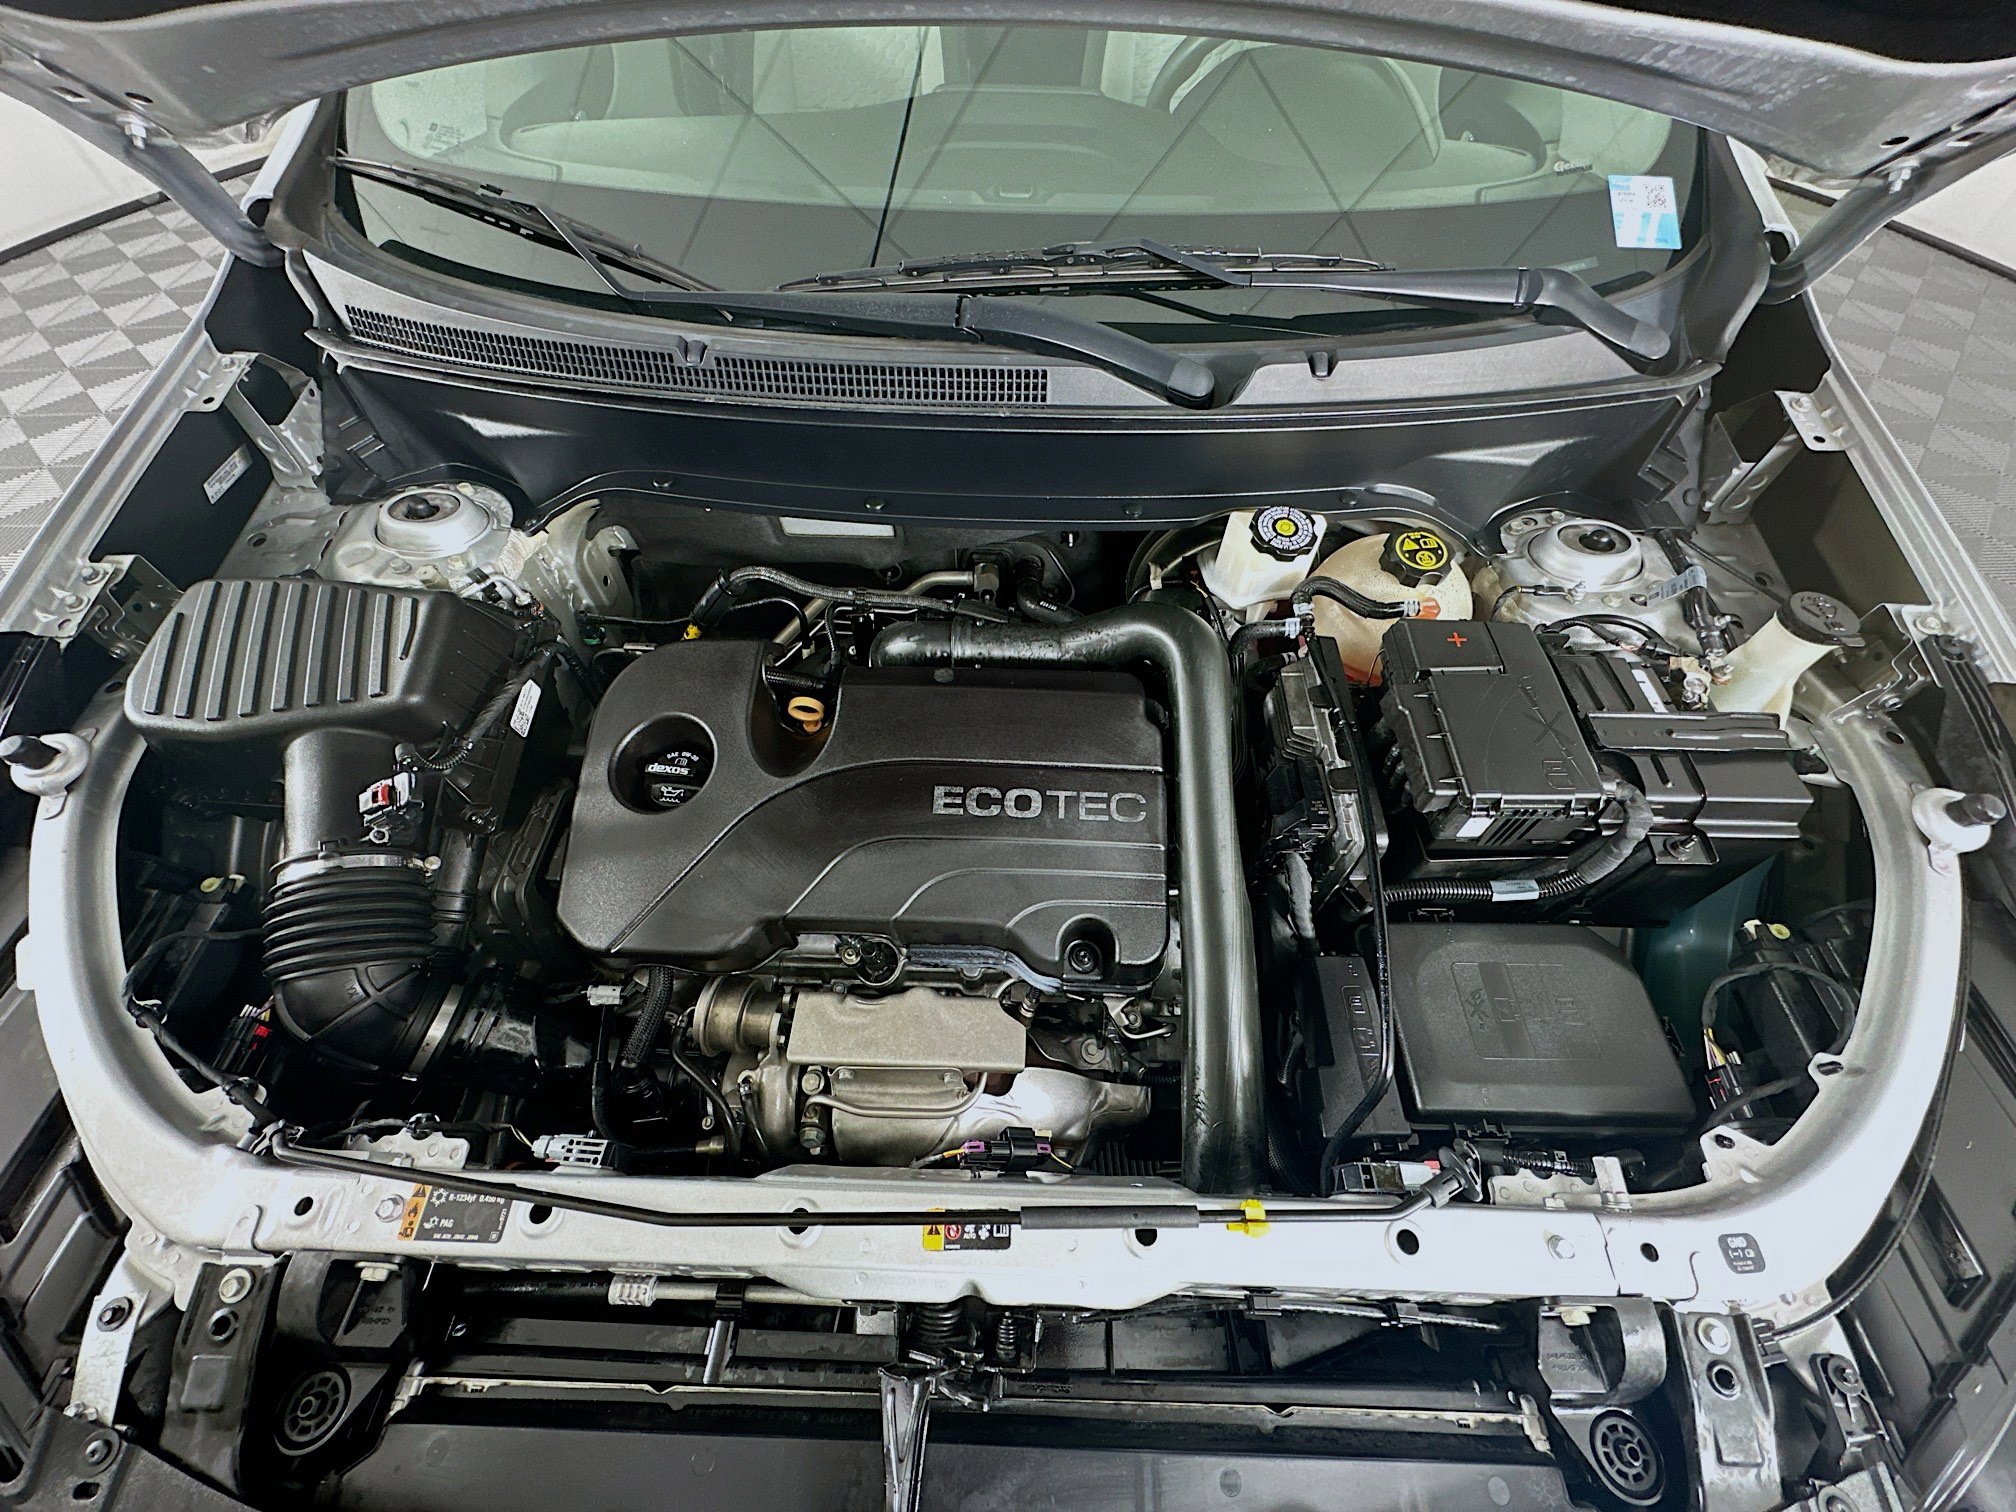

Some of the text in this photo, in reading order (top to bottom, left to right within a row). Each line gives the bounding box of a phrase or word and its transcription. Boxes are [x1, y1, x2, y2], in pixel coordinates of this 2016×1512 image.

[647, 762, 690, 775] dexos
[932, 785, 1147, 823] ECOTEC
[439, 1218, 454, 1228] PAG
